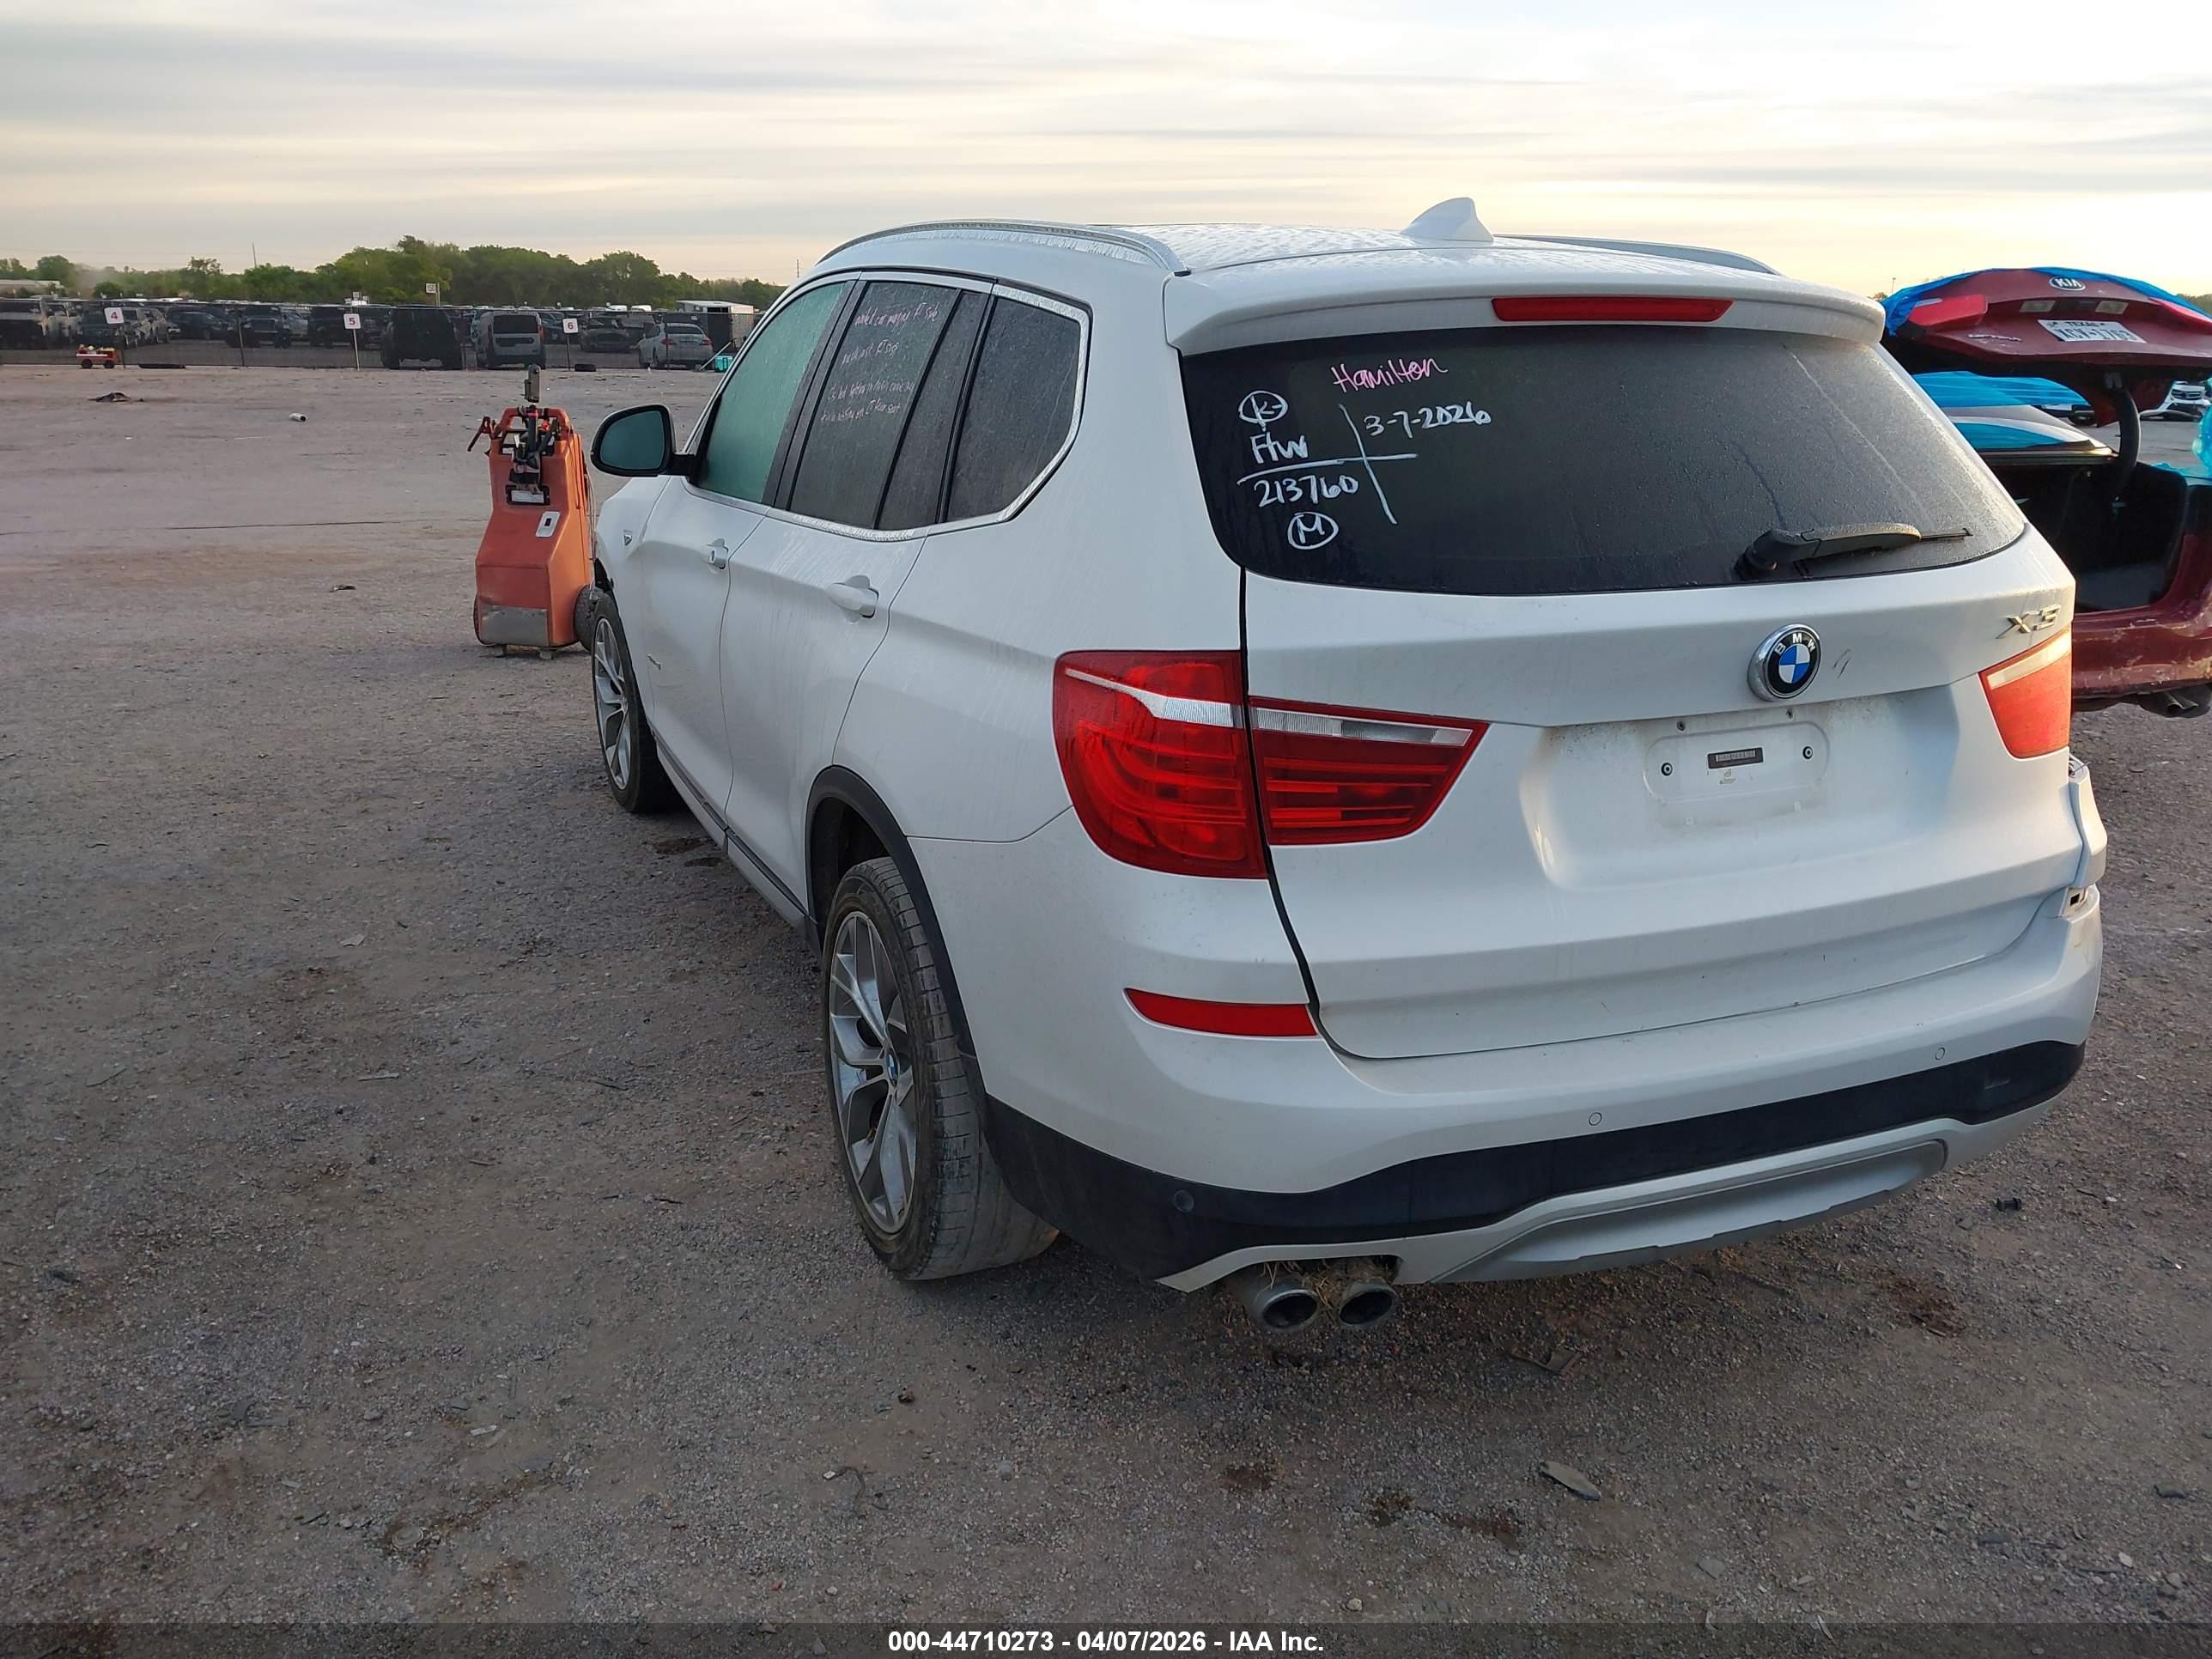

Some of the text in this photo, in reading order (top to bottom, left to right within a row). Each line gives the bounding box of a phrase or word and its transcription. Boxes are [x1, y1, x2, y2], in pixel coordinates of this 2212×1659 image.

[2054, 278, 2082, 288] KIA
[110, 311, 118, 319] 4
[349, 317, 356, 325] 5
[567, 321, 574, 330] 6
[1331, 357, 1449, 393] Hamilton
[1364, 401, 1492, 439] 3-7-2026
[1254, 474, 1359, 507] 213760
[1995, 604, 2062, 640] X3
[1774, 632, 1816, 655] BMW
